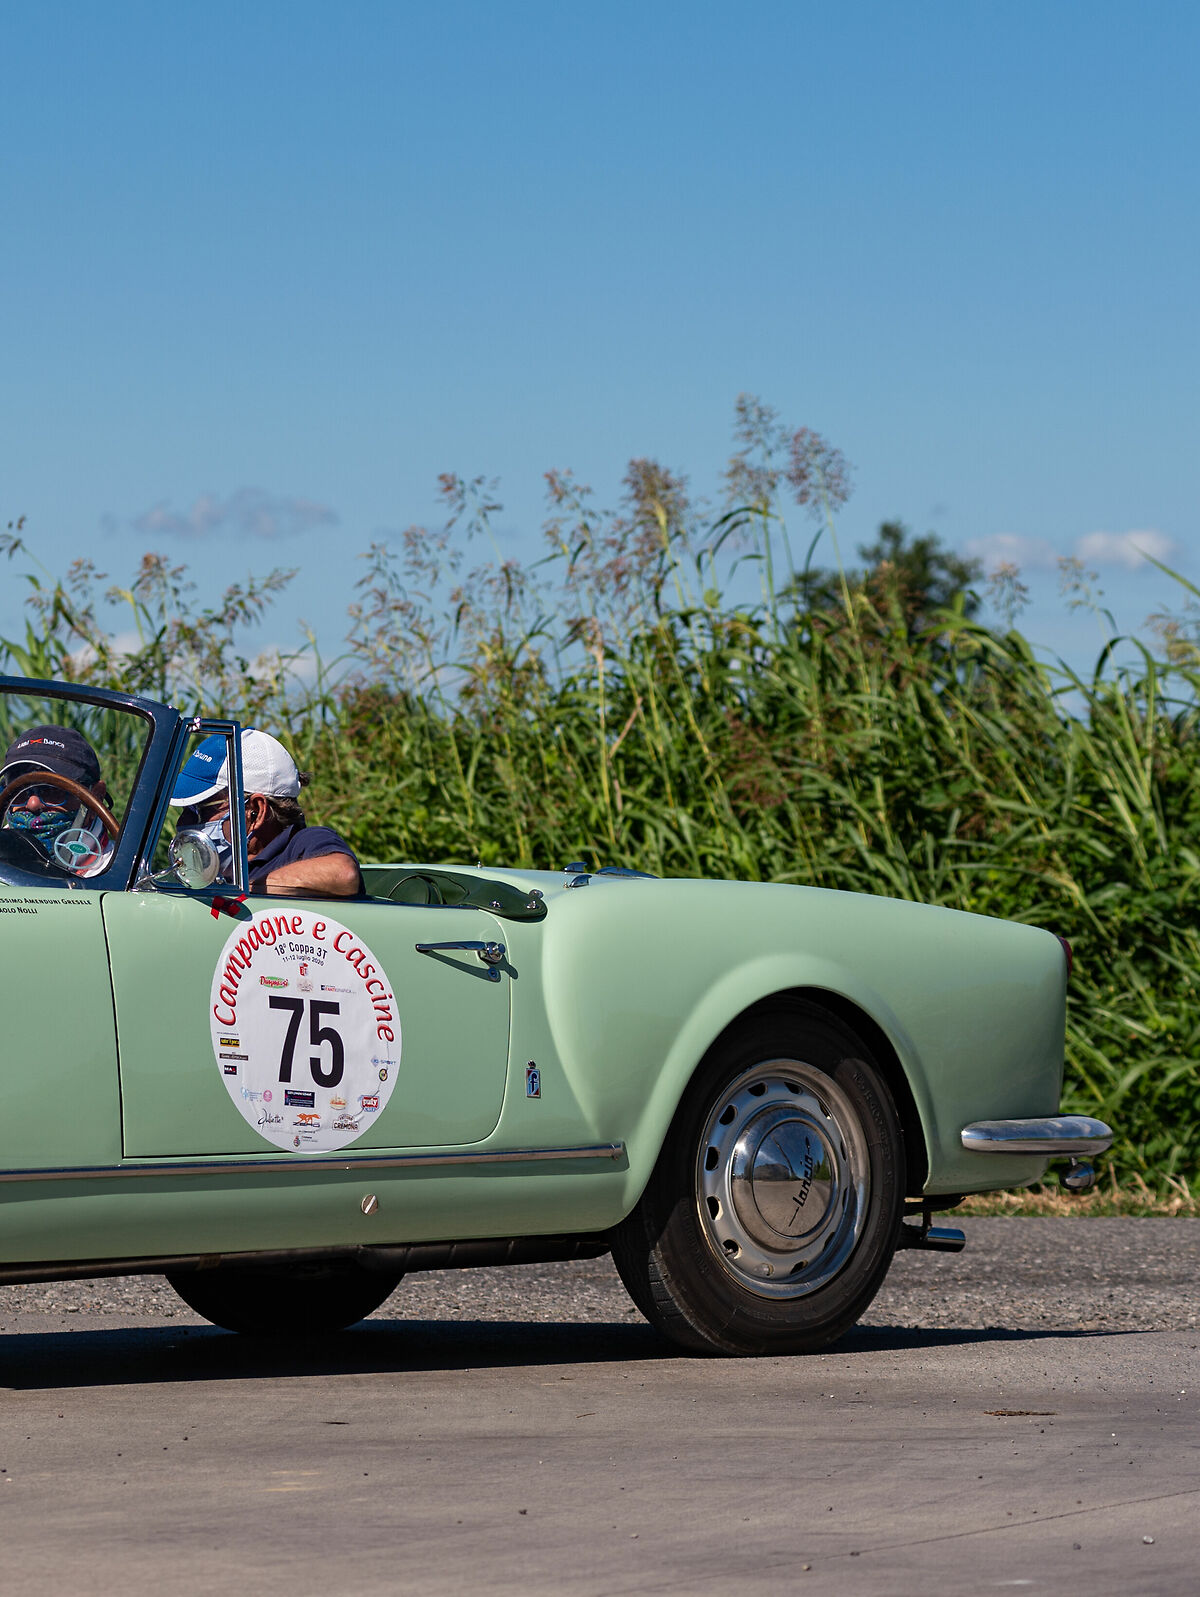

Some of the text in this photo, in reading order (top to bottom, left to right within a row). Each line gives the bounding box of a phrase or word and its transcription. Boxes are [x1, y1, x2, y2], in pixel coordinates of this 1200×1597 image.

[213, 914, 396, 1043] Campagne e Cascine
[289, 941, 315, 955] Coppa
[316, 947, 328, 960] 3T
[268, 995, 345, 1088] 75
[334, 1122, 358, 1130] CREMONA
